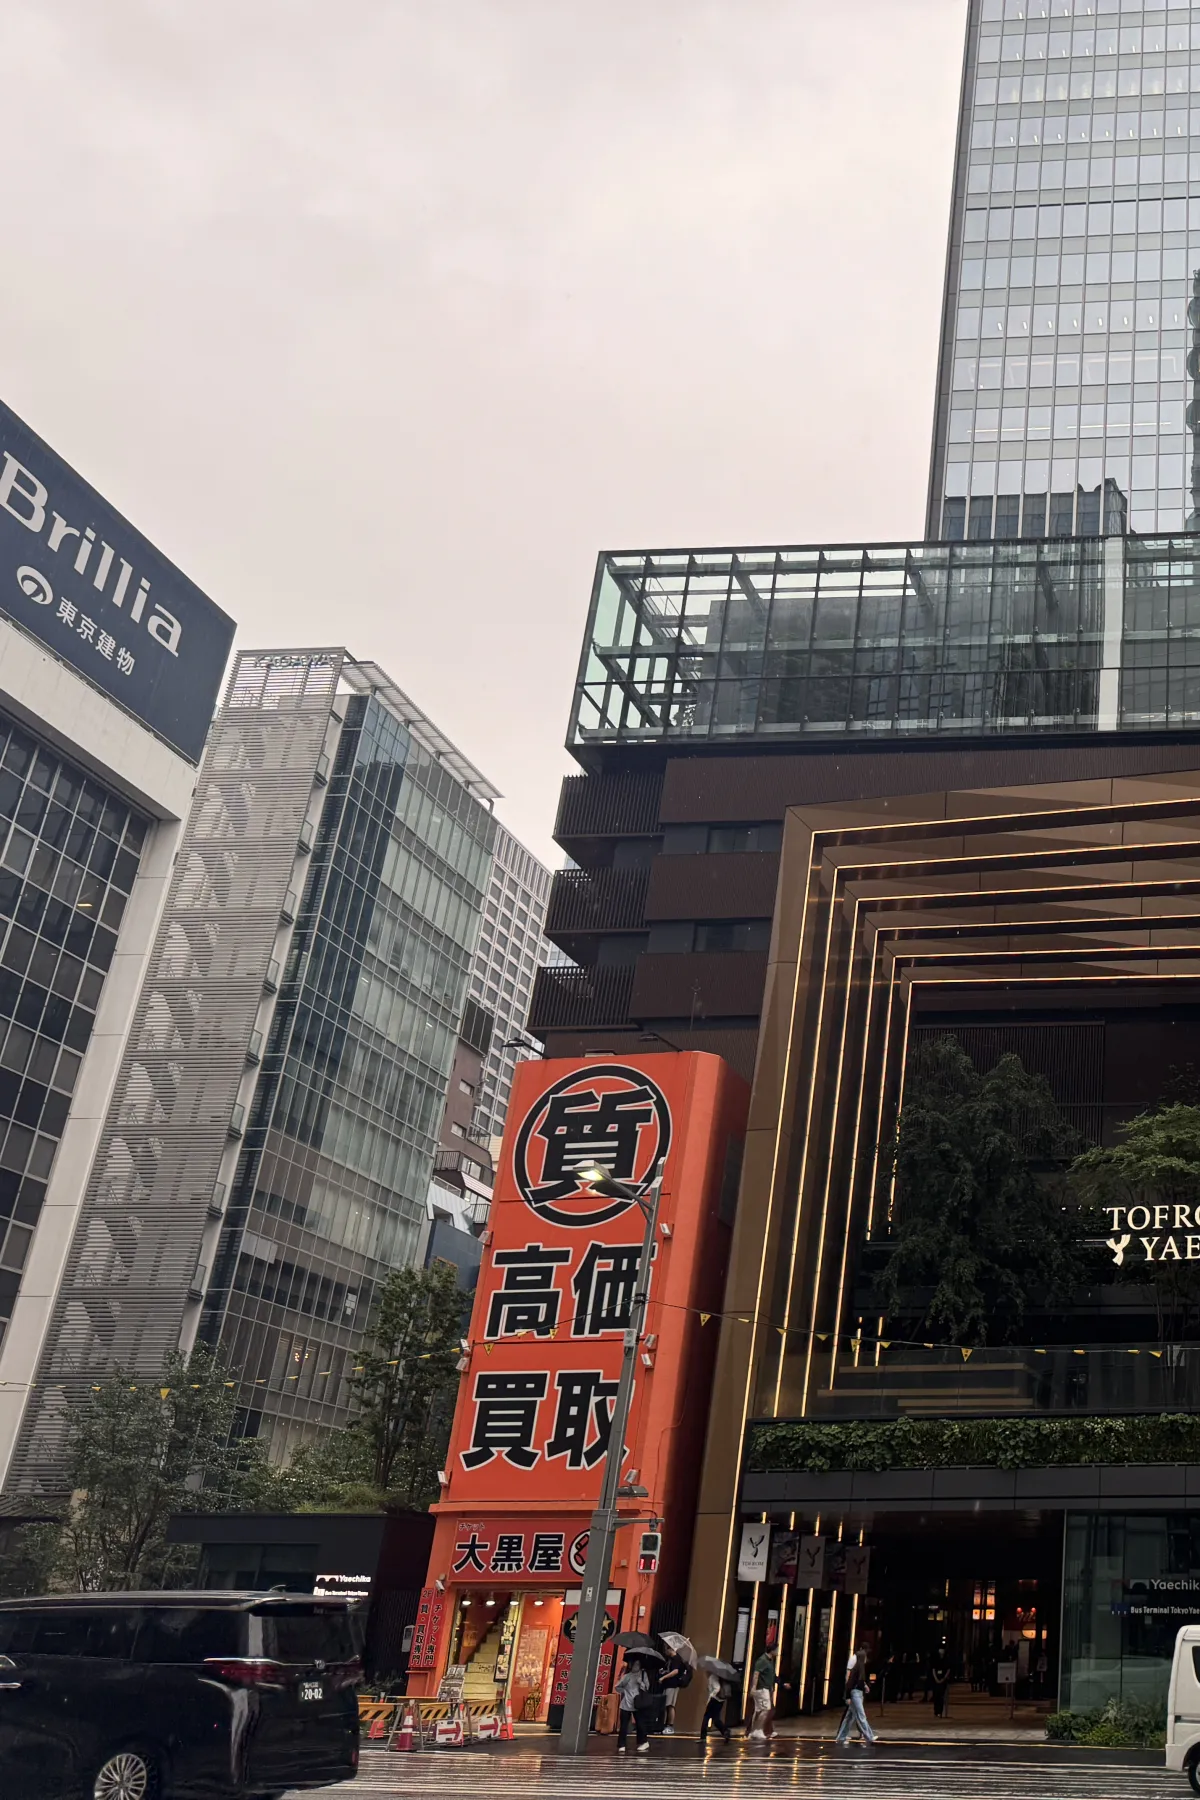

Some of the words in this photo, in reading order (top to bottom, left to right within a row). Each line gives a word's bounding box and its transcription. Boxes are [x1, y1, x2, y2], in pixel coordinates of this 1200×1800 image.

[0, 452, 183, 657] Brillia
[56, 597, 136, 676] 東京建物
[523, 1085, 656, 1207] 質
[485, 1240, 657, 1341] 高価
[459, 1368, 636, 1472] 買取
[452, 1532, 565, 1574] 大黒屋
[458, 1522, 486, 1531] チケット
[422, 1590, 433, 1598] 2F
[1130, 1606, 1142, 1614] Bus
[1143, 1606, 1170, 1614] Terminal
[1170, 1606, 1189, 1615] Tokyo
[424, 1604, 442, 1665] チケット専門
